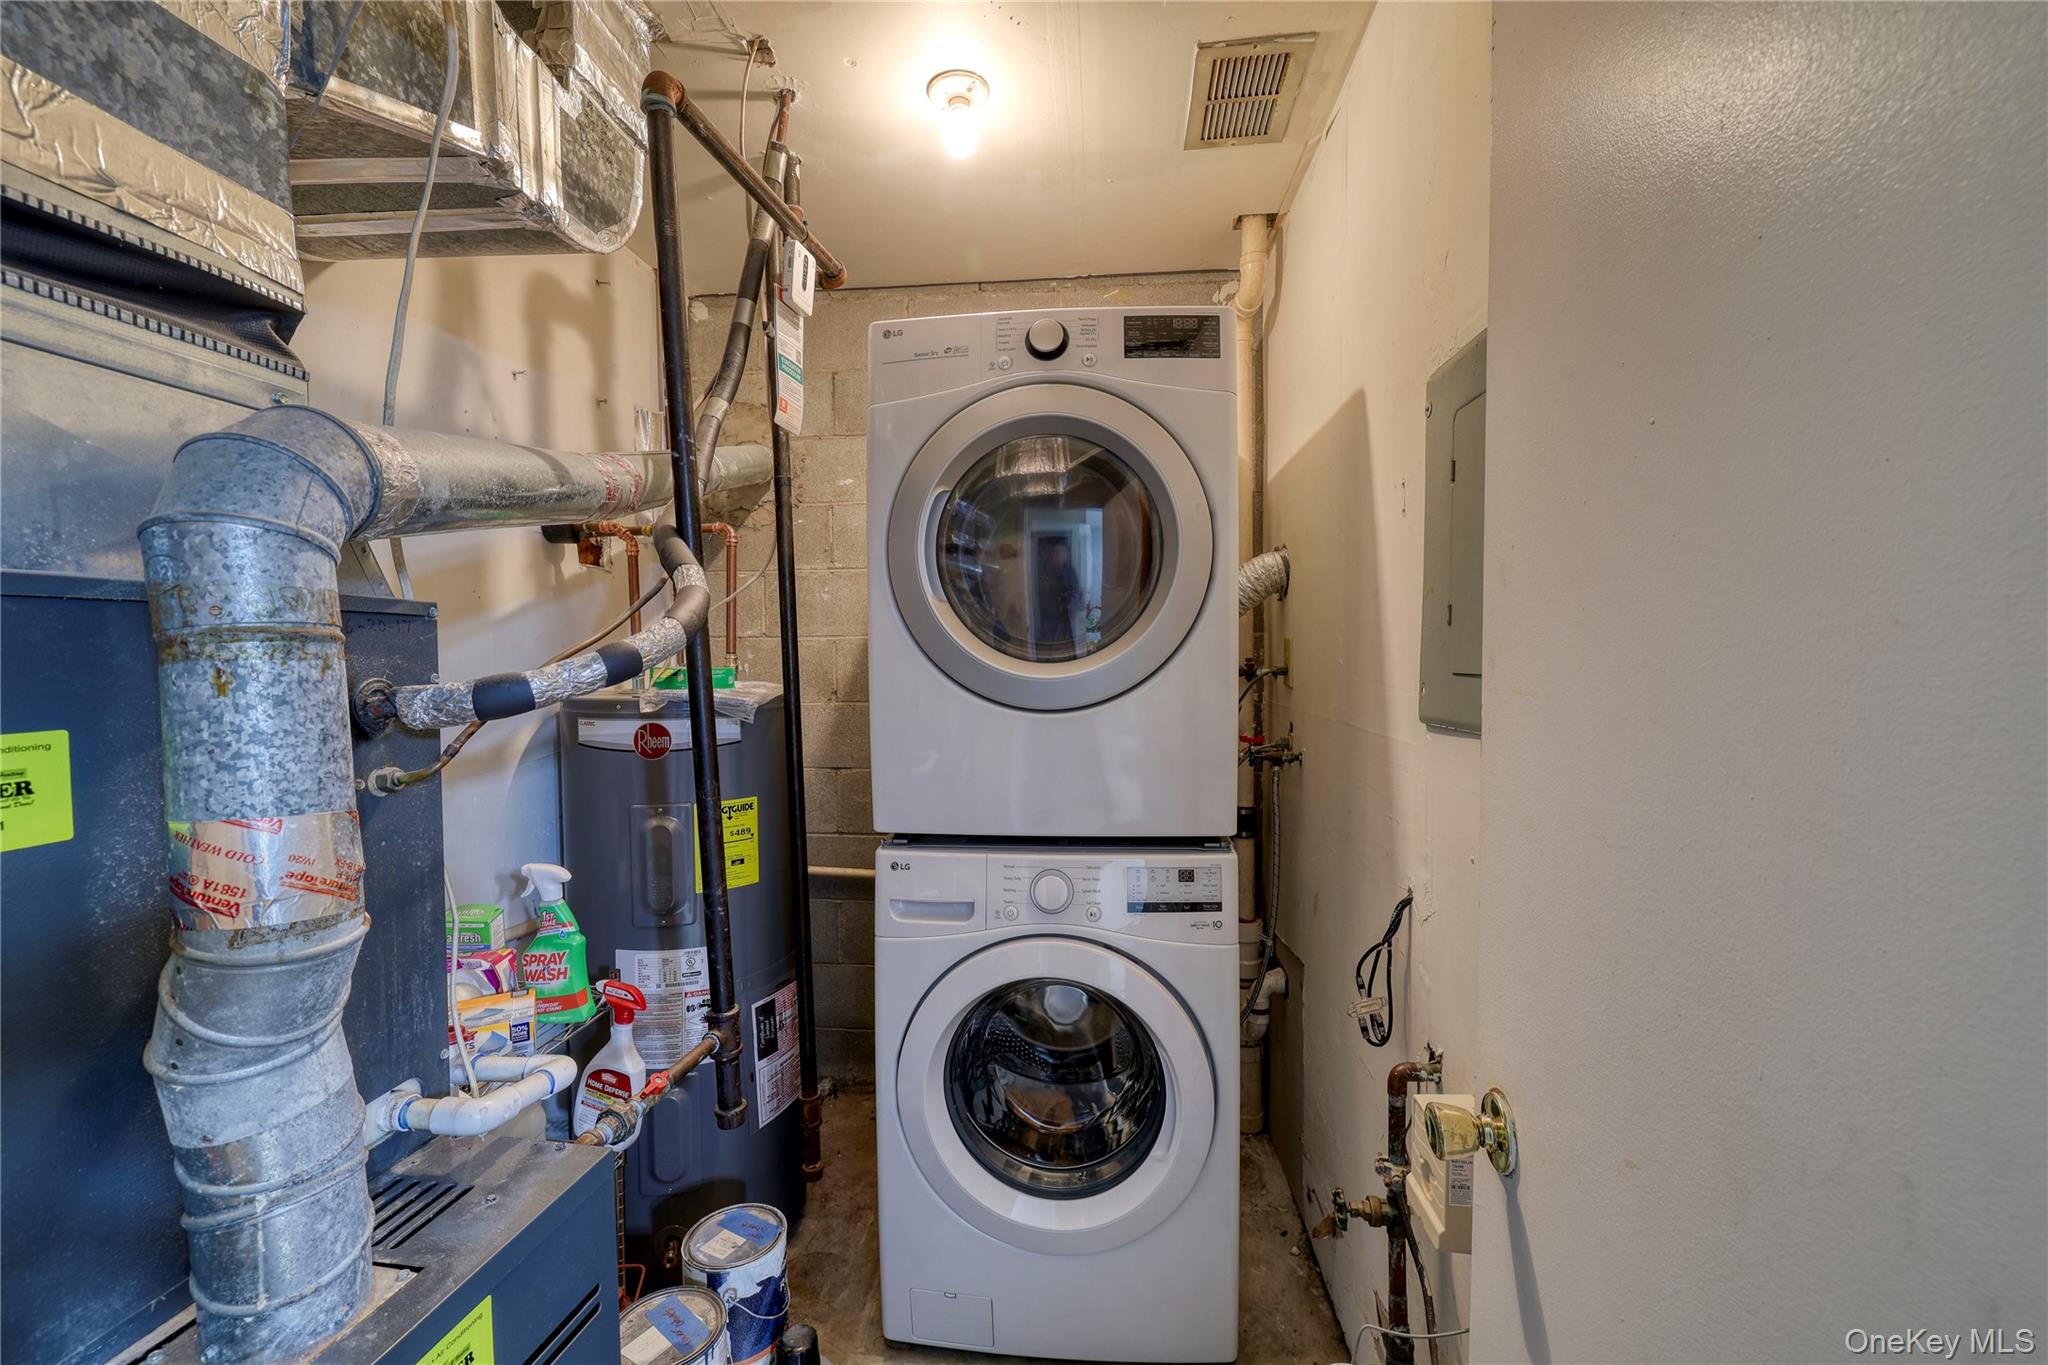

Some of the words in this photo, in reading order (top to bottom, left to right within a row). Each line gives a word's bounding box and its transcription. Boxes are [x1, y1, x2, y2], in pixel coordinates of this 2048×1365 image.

[638, 724, 670, 754] Rheem
[722, 801, 754, 815] GYGUIDE
[203, 878, 249, 899] 1581A
[523, 952, 566, 967] SPRAY
[525, 966, 568, 982] WASH
[587, 1078, 604, 1090] HOME
[603, 1084, 630, 1099] DEFENSE
